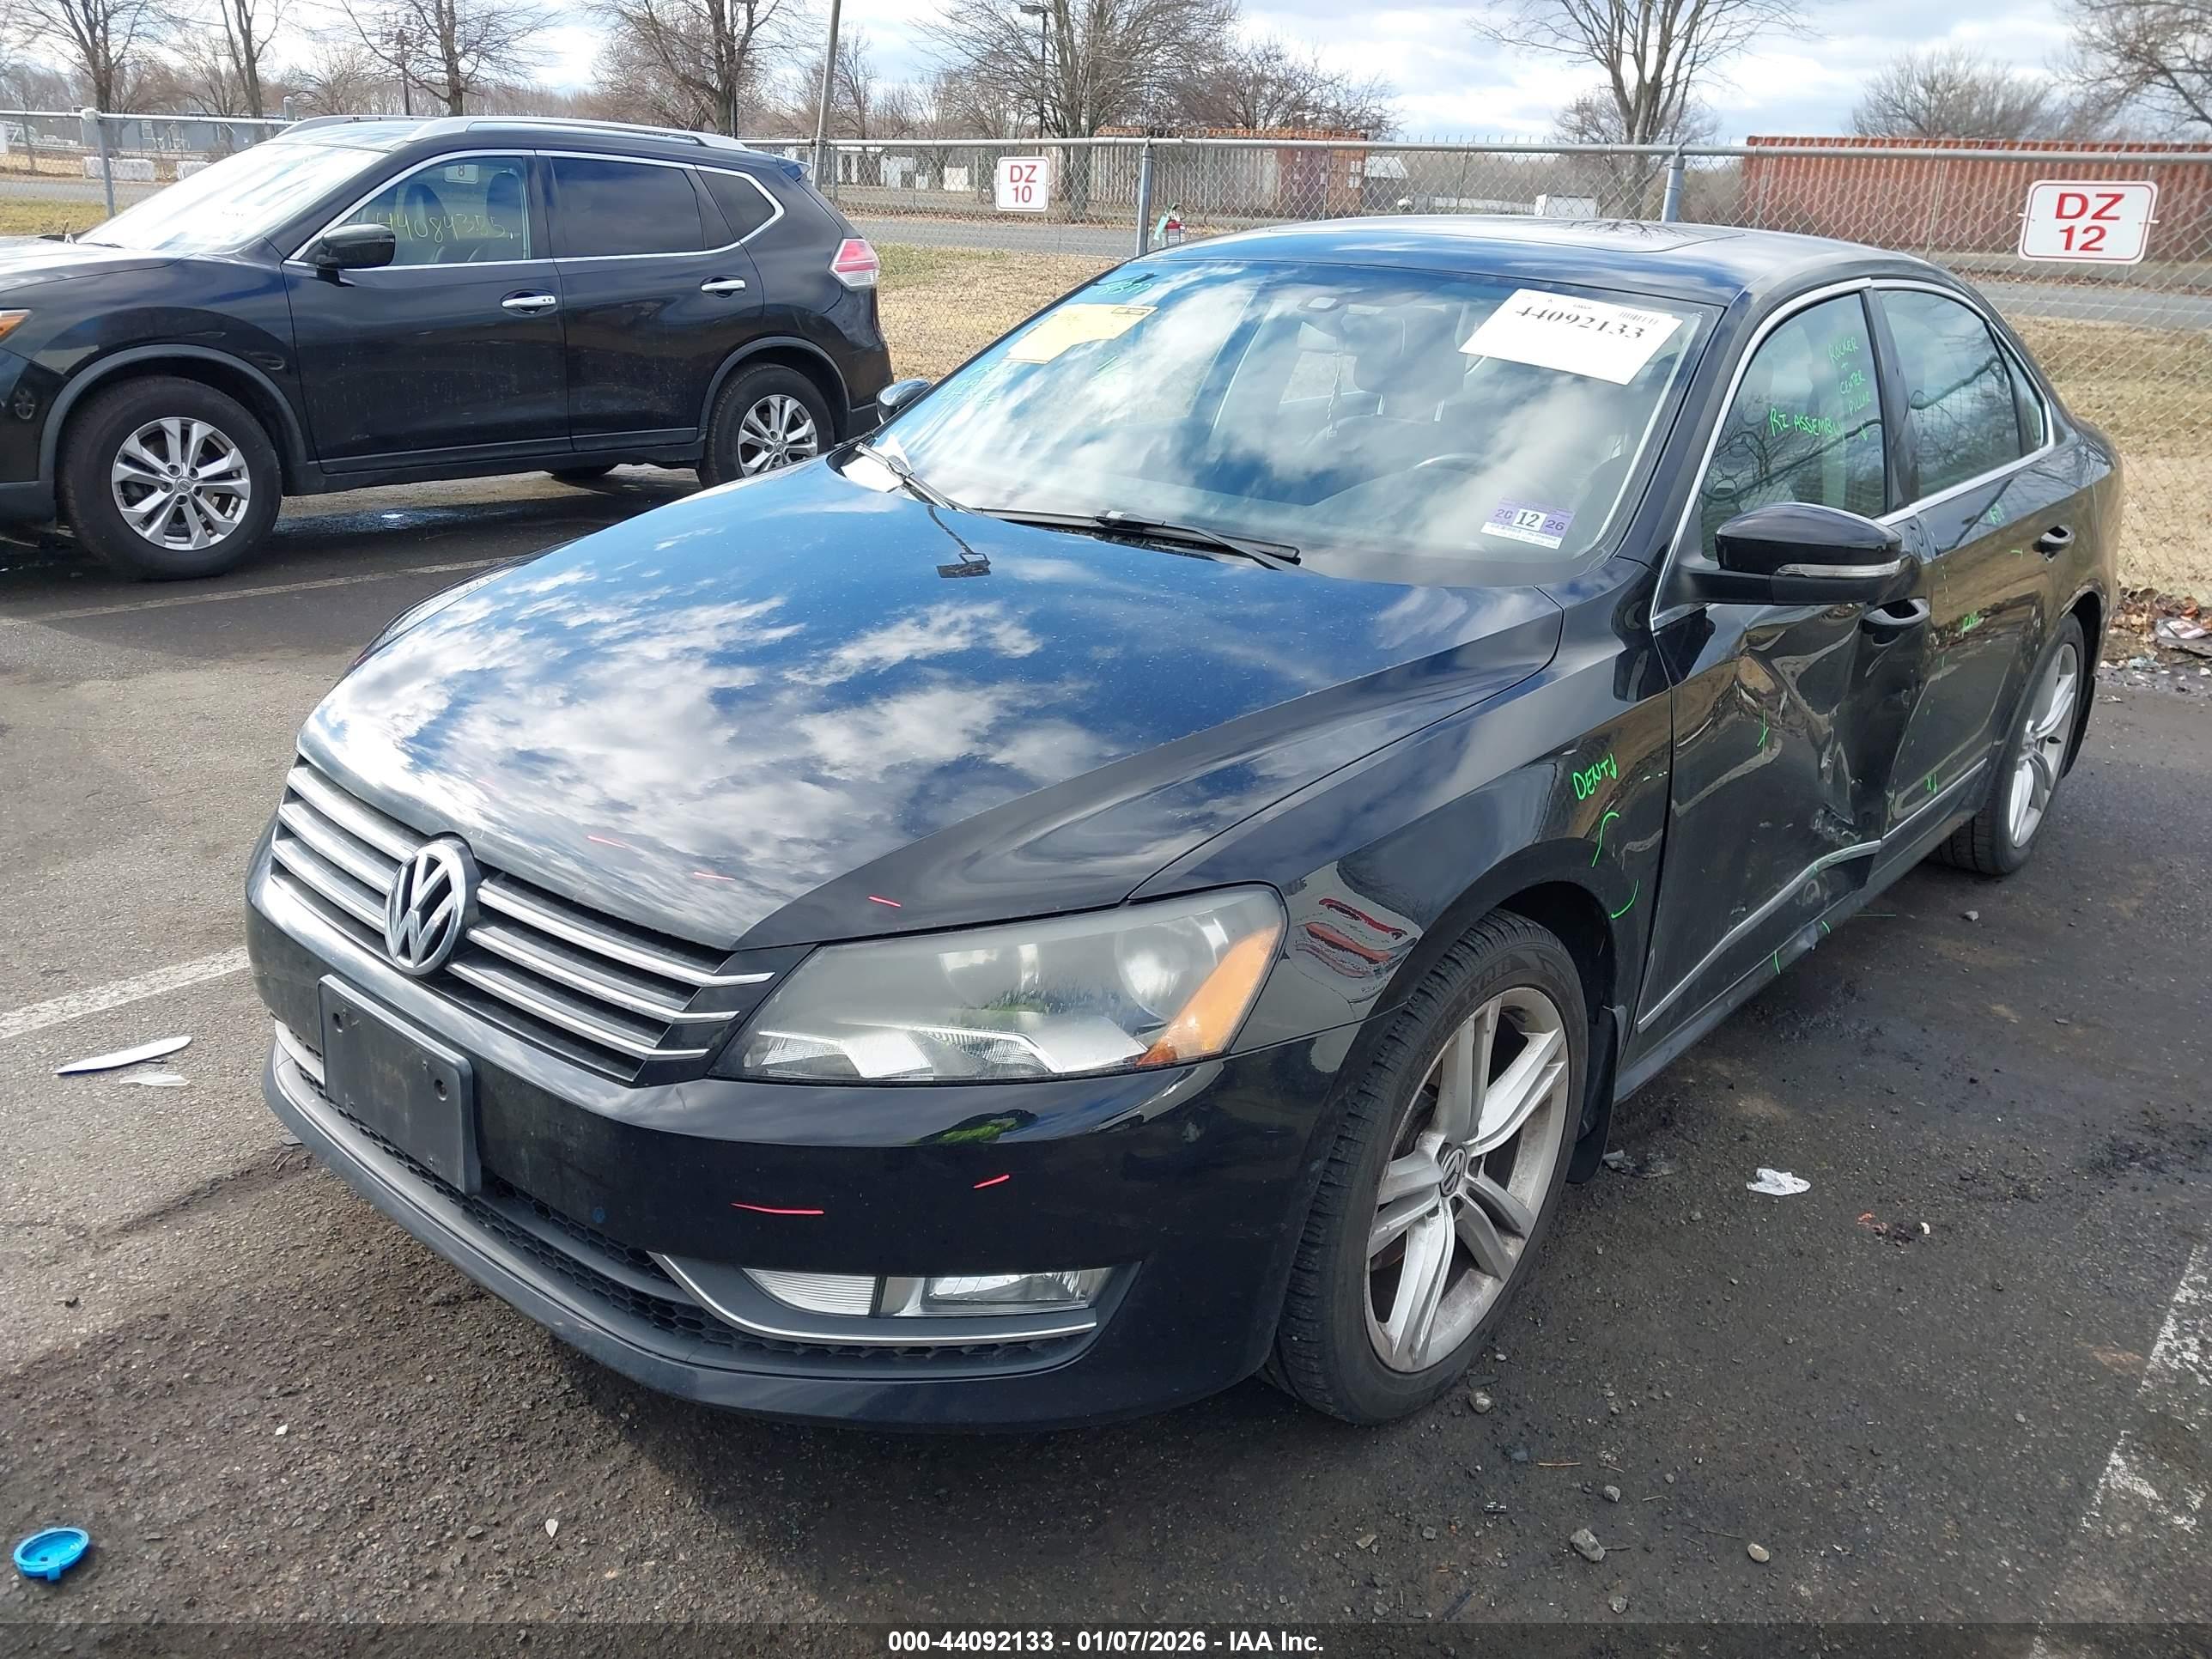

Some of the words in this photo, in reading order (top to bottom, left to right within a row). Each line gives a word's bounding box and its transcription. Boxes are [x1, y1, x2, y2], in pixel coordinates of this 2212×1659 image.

[1009, 165, 1037, 183] DZ
[1012, 185, 1032, 203] 10
[2055, 192, 2125, 221] DZ
[2059, 225, 2106, 252] 12
[1516, 306, 1645, 339] 44092133
[1516, 511, 1540, 528] 12
[1546, 520, 1565, 531] 26
[1572, 758, 1609, 800] DENT
